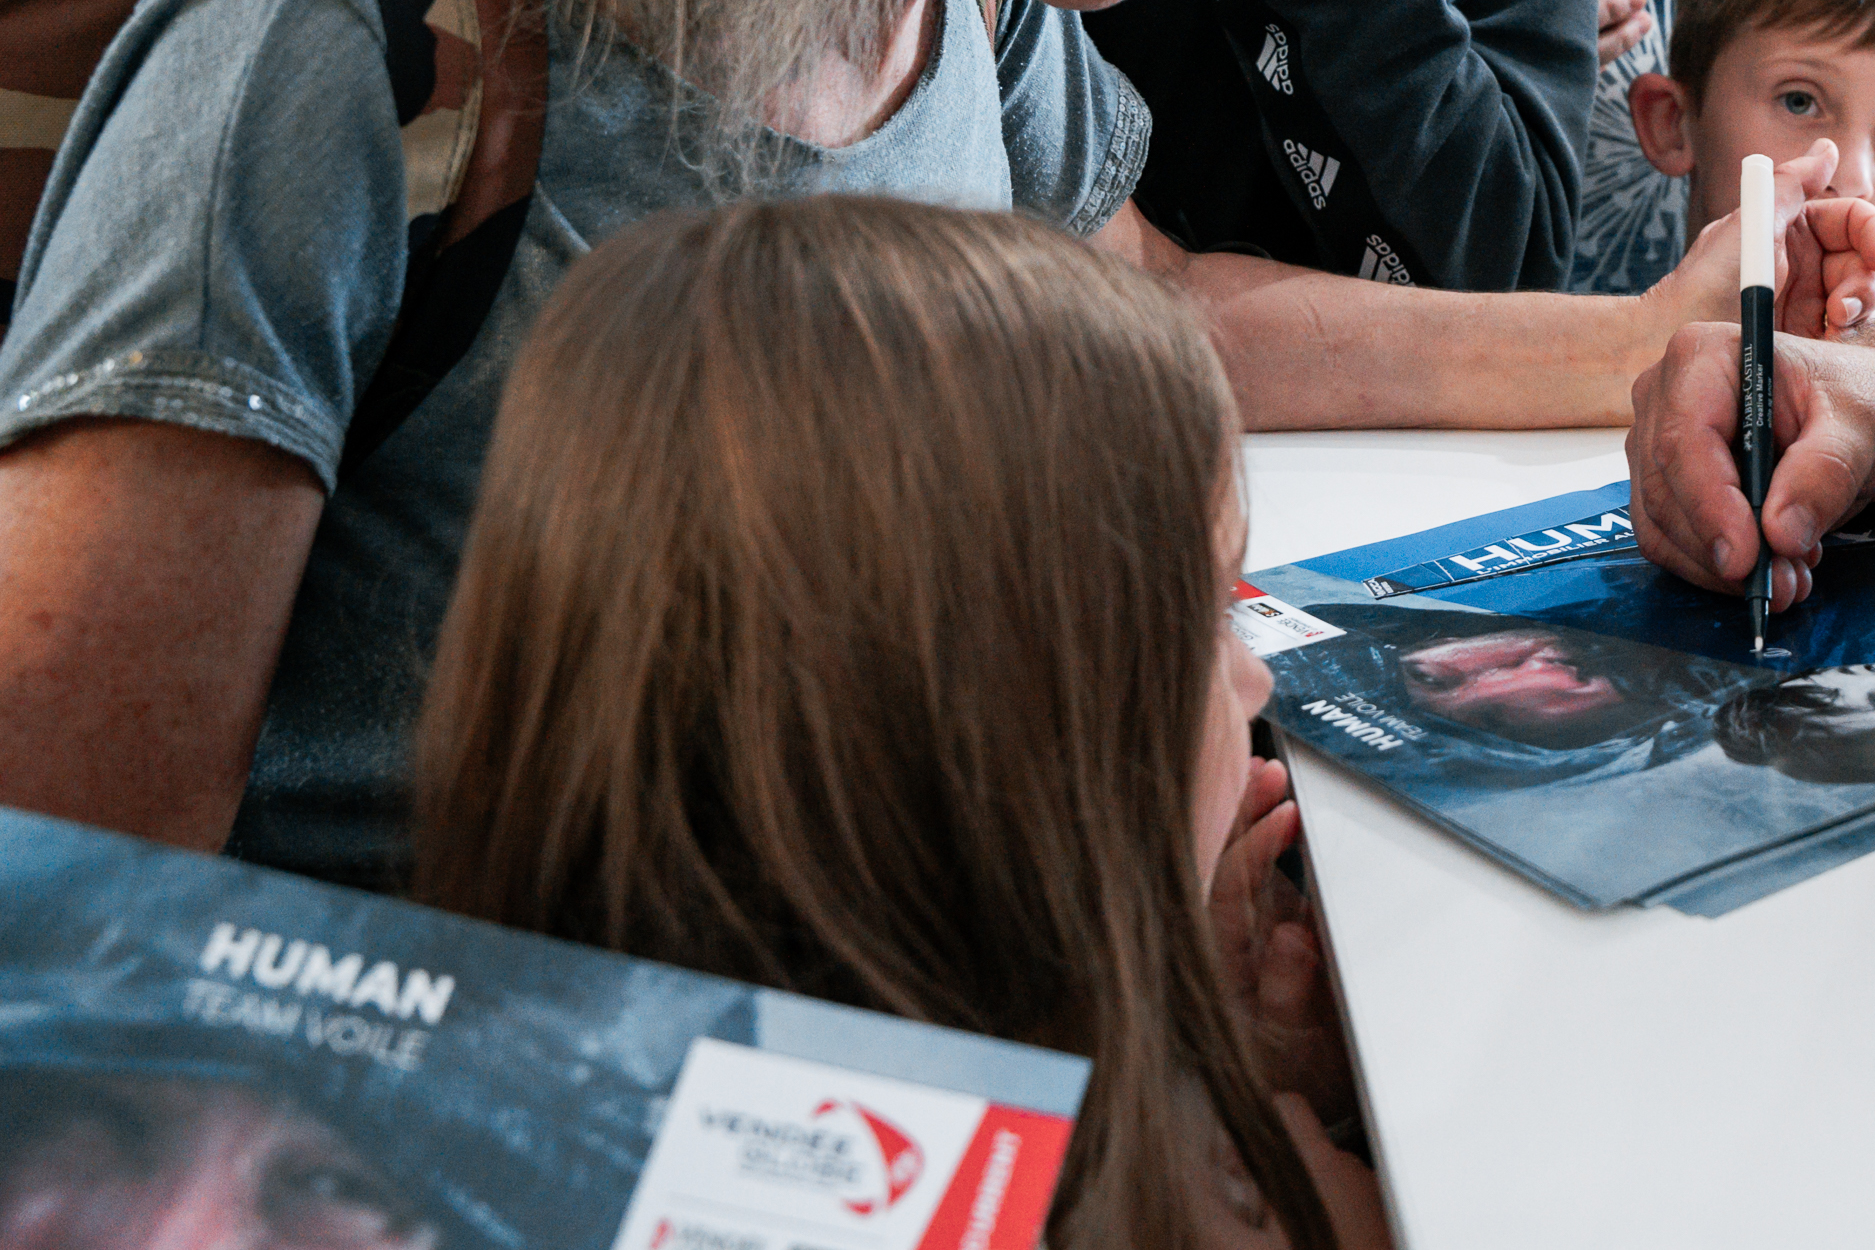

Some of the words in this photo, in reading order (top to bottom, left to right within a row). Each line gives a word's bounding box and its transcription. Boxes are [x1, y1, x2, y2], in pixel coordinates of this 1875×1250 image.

[1264, 23, 1294, 95] adidas
[1283, 139, 1326, 210] adidas
[1756, 364, 1764, 391] Marker
[1756, 393, 1764, 427] Creative
[1449, 512, 1633, 573] HUM
[1476, 538, 1610, 576] L'IMMOBILIER
[1301, 699, 1404, 751] HUMAN
[1334, 691, 1385, 720] VOILE
[1378, 715, 1429, 741] TEAM
[201, 921, 456, 1027] HUMAN
[183, 977, 302, 1039] TEAM
[304, 1005, 431, 1072] VOILE
